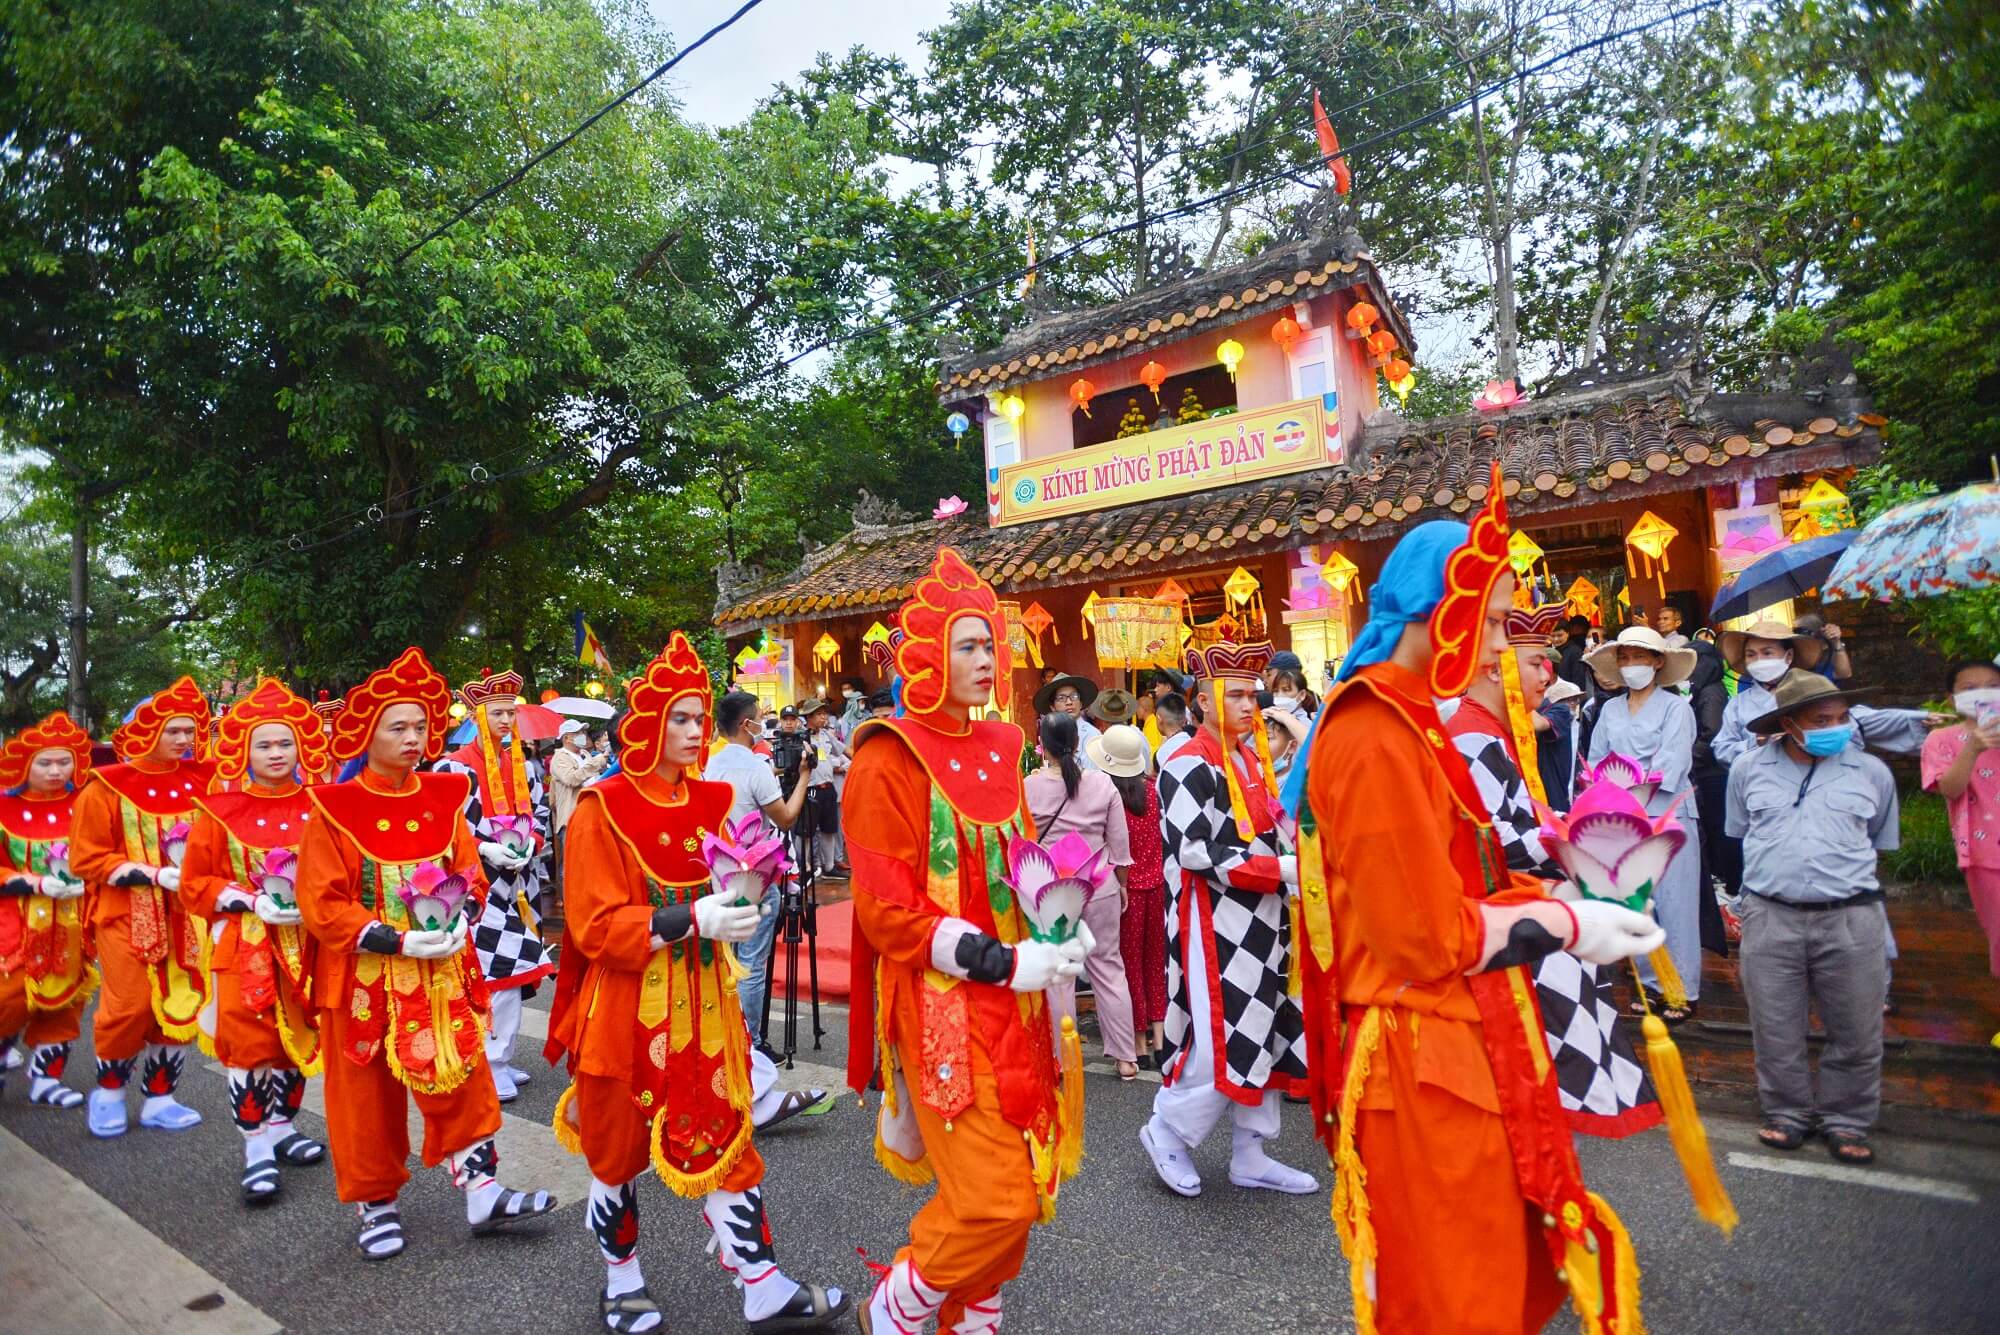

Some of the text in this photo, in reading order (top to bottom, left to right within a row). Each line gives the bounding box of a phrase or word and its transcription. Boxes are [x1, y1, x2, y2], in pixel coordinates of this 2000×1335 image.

[1042, 468, 1088, 501] KÍNH
[1094, 455, 1151, 490] MỪNG
[1157, 440, 1212, 479] PHẬT
[1220, 424, 1266, 465] ĐẢN
